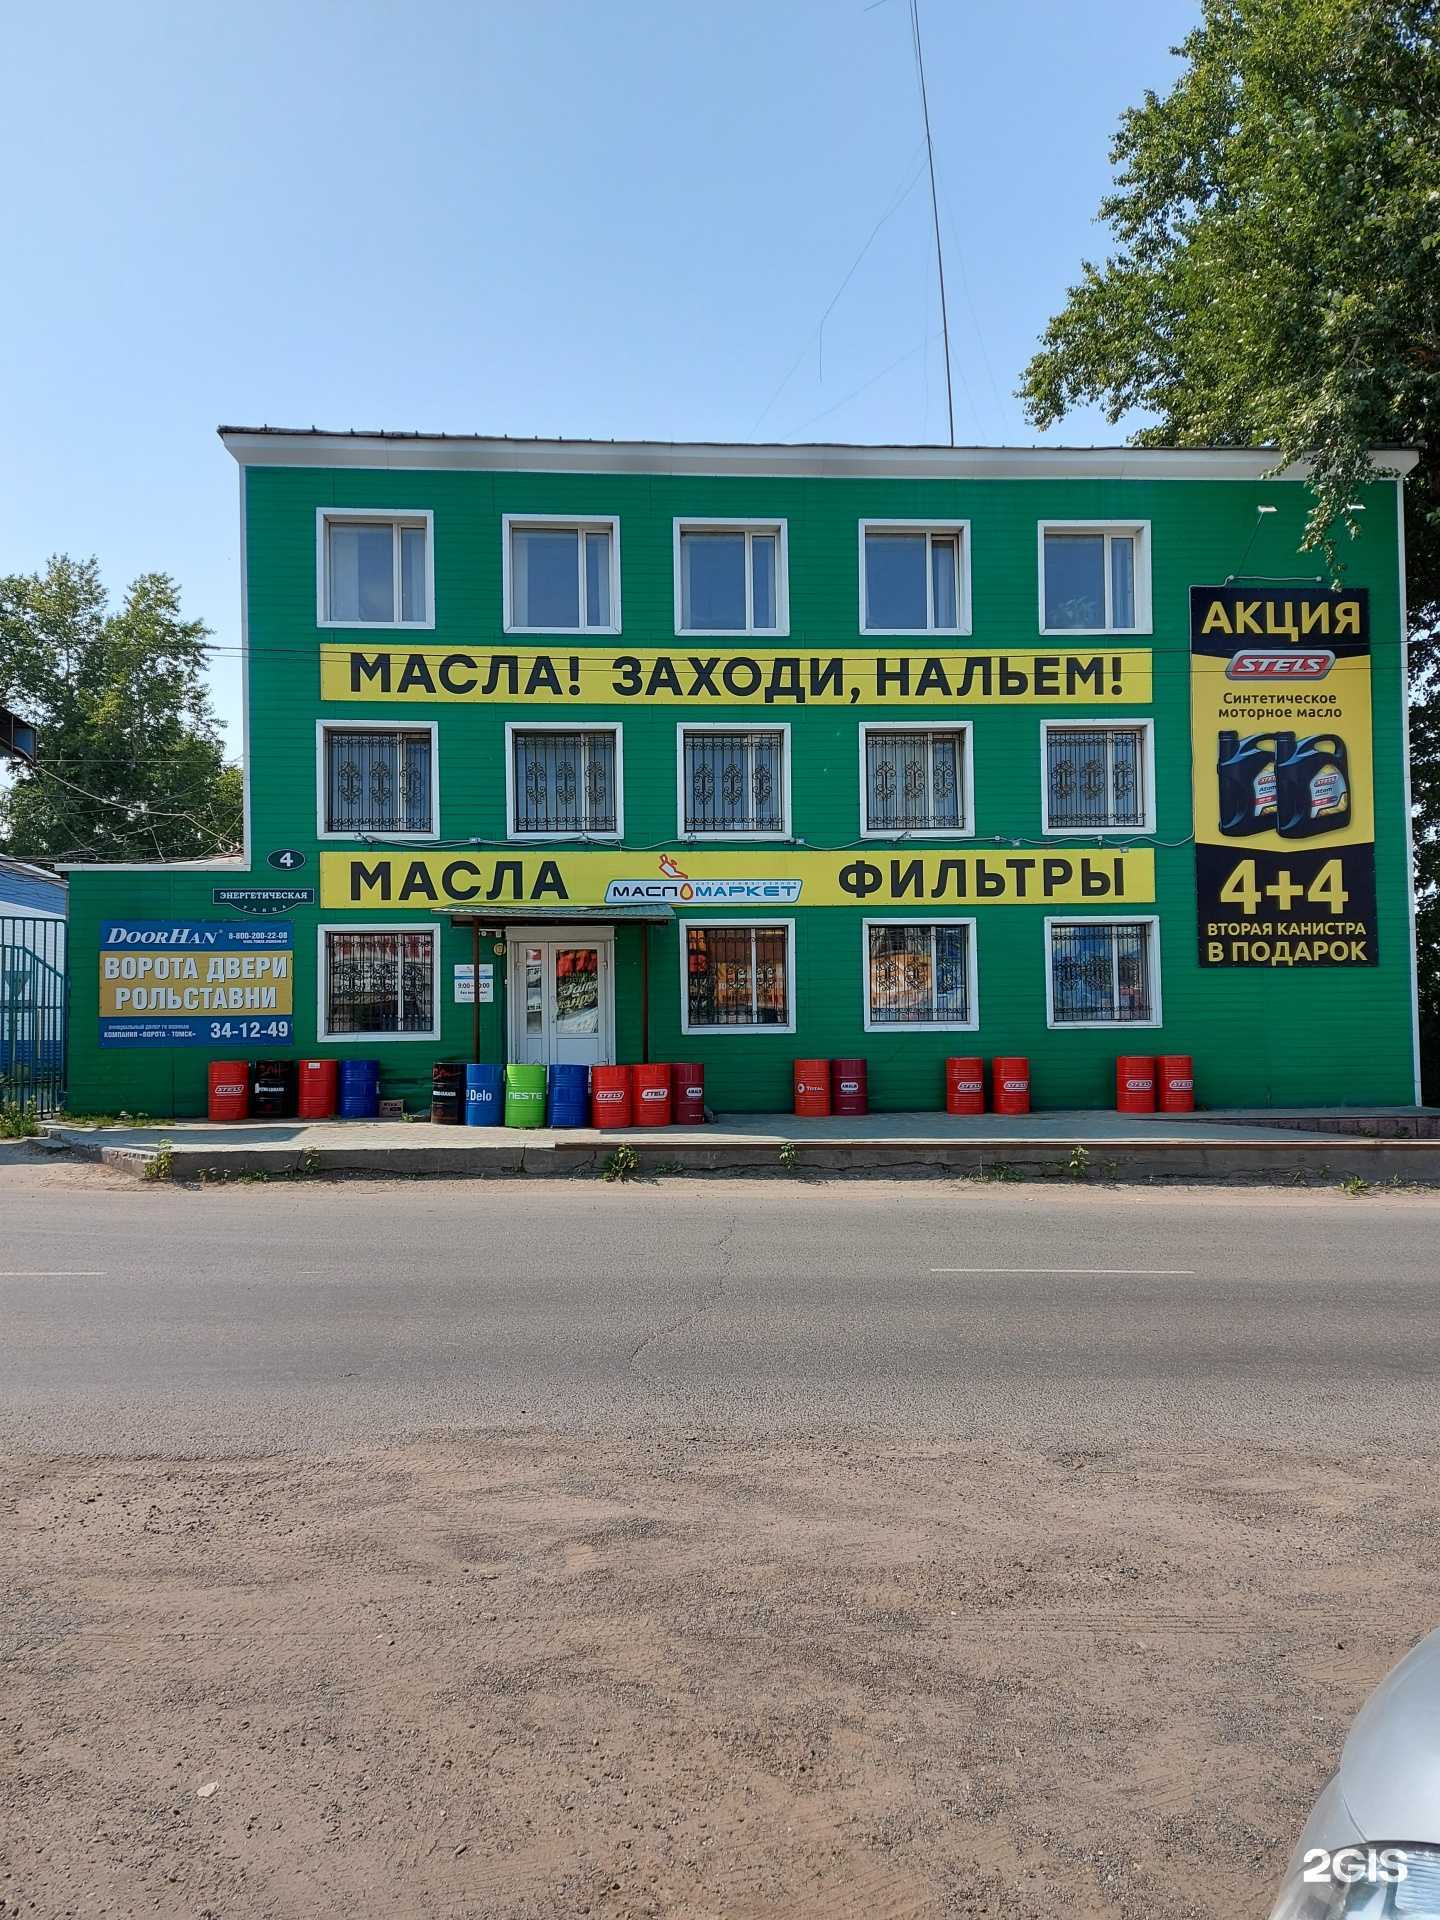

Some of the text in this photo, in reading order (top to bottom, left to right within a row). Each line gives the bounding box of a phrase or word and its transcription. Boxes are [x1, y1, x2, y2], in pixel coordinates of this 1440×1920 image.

[1201, 601, 1361, 642] АКЦИЯ
[1236, 658, 1325, 673] STELS
[350, 652, 1122, 703] МАСЛА! ЗАХОДИ, НАЛЬЕМ!
[1223, 692, 1337, 704] Синтетическое
[1218, 707, 1343, 720] моторное масло
[279, 852, 294, 867] 4
[350, 861, 569, 901] МАСЛА
[838, 858, 1124, 899] ФИЛЬТРЫ
[1220, 859, 1349, 915] 4+4
[219, 891, 308, 900] ЭНЕРГЕТИЧЕСКАЯ
[1207, 922, 1367, 936] ВТОРАЯ КАНИСТРА
[1207, 941, 1368, 966] В ПОДАРОК
[104, 956, 288, 983] ВОРОТА ДВЕРИ
[115, 987, 277, 1010] РОЛЬСТАВНИ
[210, 1021, 289, 1038] 34-12-49
[470, 1089, 493, 1102] Delo
[508, 1091, 543, 1100] NESTE
